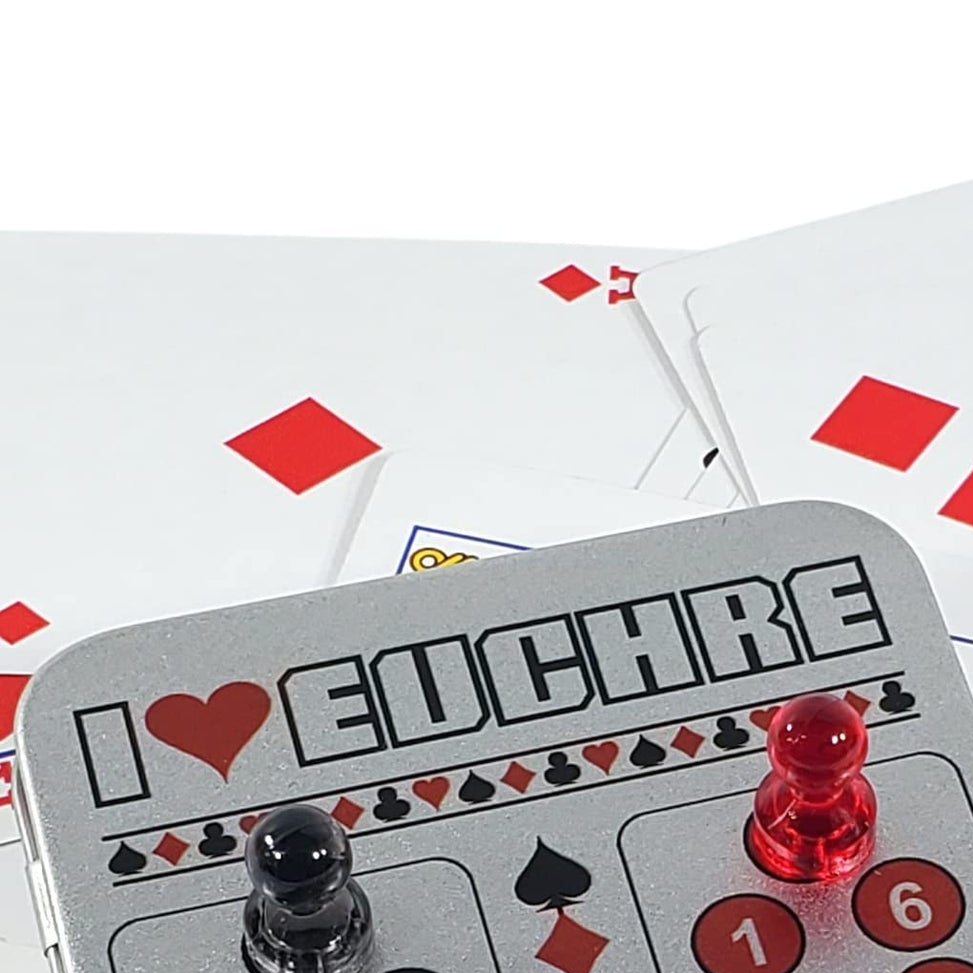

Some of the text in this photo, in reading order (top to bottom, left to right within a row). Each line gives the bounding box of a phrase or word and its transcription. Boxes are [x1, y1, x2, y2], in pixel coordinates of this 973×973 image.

[73, 554, 893, 809] I EUCHRE
[889, 881, 933, 930] 6
[731, 918, 767, 966] 1
